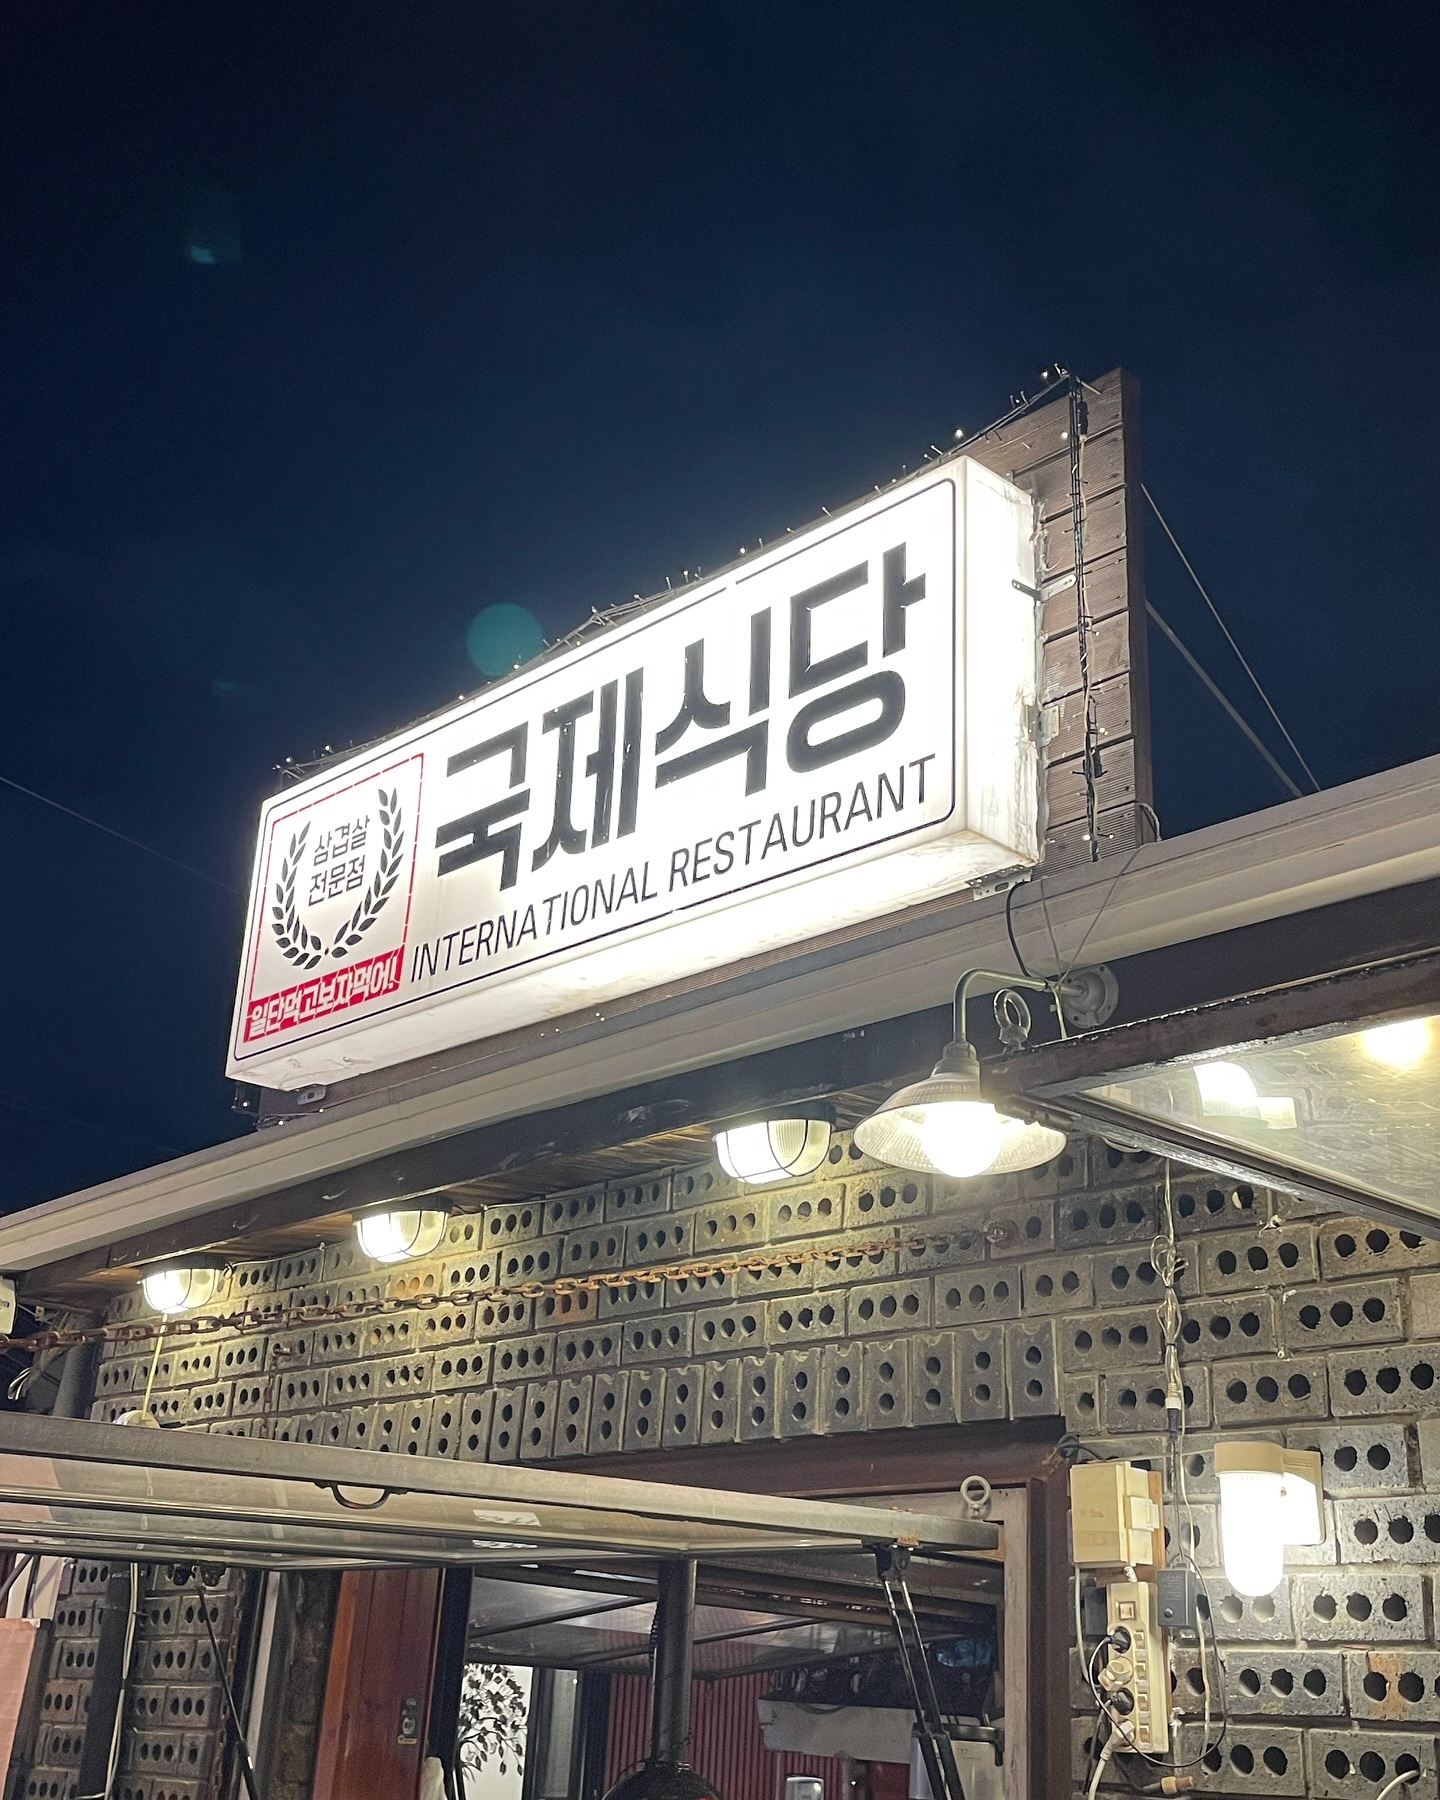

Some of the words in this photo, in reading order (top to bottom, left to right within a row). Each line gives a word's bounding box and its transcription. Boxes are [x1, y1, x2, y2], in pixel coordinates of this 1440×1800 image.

[435, 542, 926, 890] 국제식당
[308, 854, 365, 907] 전문점
[314, 815, 370, 866] 삼겹살
[411, 861, 659, 982] INTERNATIONAL
[668, 754, 936, 892] RESTAURANT
